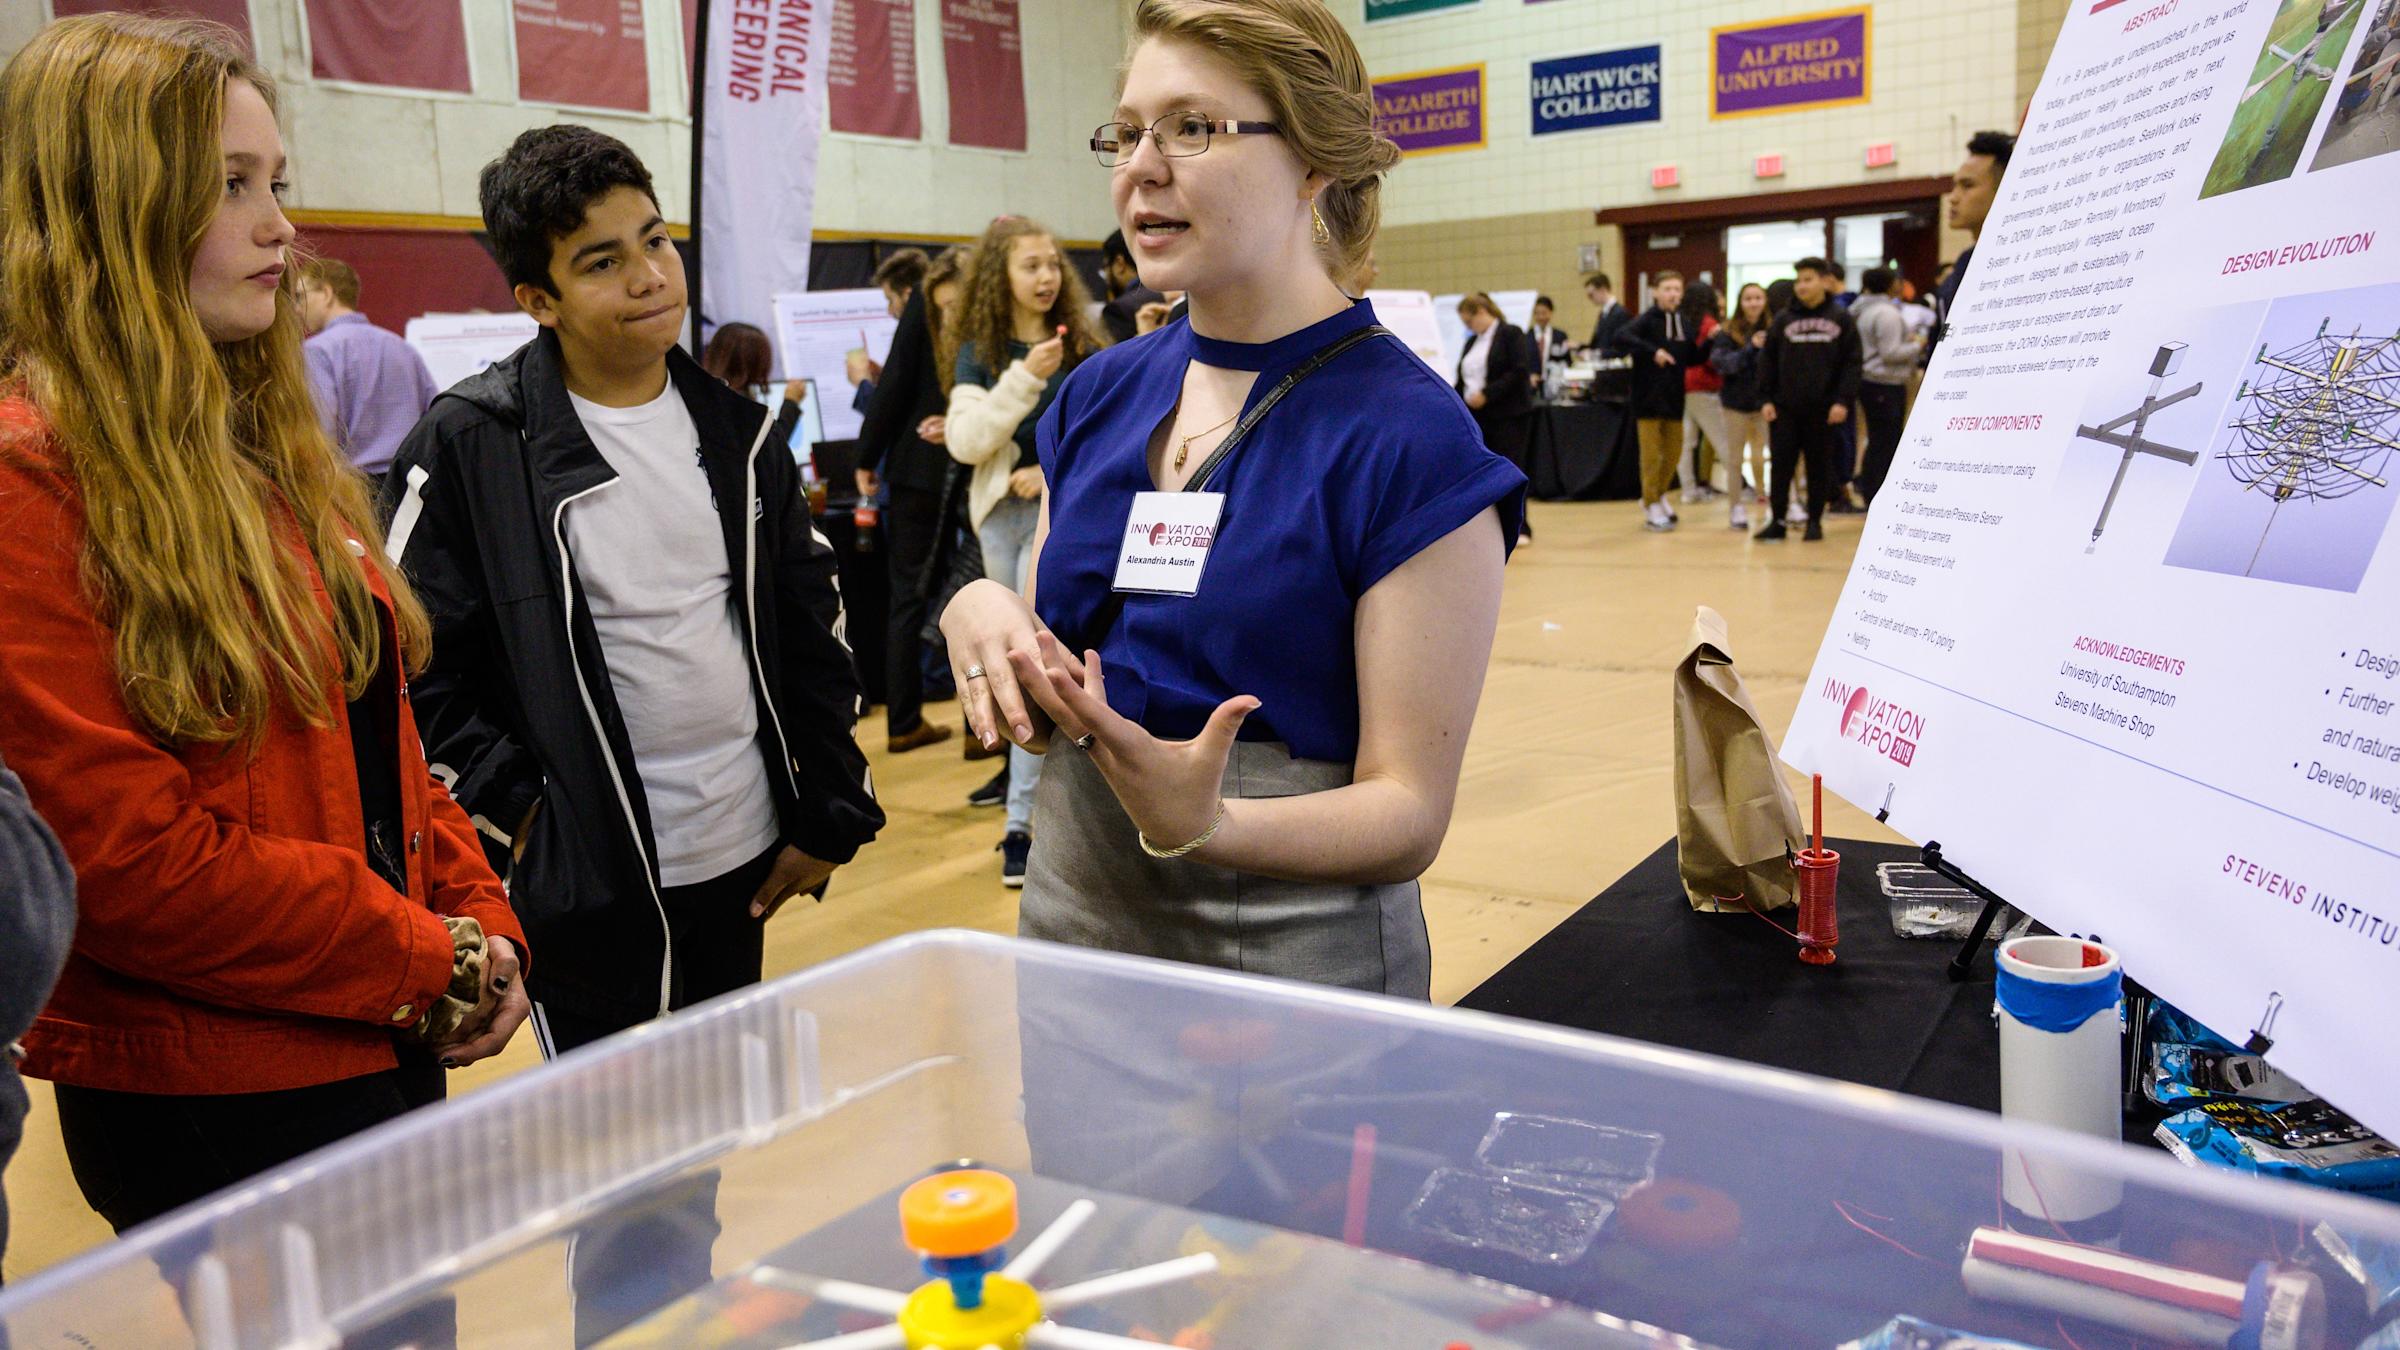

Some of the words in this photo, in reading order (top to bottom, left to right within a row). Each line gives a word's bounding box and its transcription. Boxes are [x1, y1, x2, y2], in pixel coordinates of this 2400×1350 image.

[2122, 0, 2179, 33] ABSTRACT
[1739, 37, 1840, 69] ALFRED
[1532, 62, 1659, 99] HARTWICK
[1718, 56, 1863, 94] UNIVERSITY
[1540, 87, 1651, 120] COLLEGE
[2222, 249, 2278, 275] DESIGN
[2278, 231, 2376, 266] EVOLUTION
[1947, 417, 1982, 430] SYSTEM
[1982, 414, 2042, 430] COMPONENTS
[1920, 436, 1932, 447] Hub
[1919, 458, 1942, 470] Custom
[1942, 460, 1983, 473] manufactured
[1982, 463, 2013, 474] aluminum
[2013, 466, 2035, 479] casing
[1901, 478, 1923, 491] Sensor
[1922, 482, 1937, 493] suite
[1901, 501, 1917, 514] Dual
[1979, 511, 2003, 525] Sensor
[1155, 534, 1191, 547] EXPO
[1908, 528, 1929, 542] rotating
[1928, 532, 1951, 543] camera
[1126, 556, 1166, 565] Alexandria
[1168, 557, 1194, 566] Austin
[1884, 546, 1905, 559] Inertial
[1904, 548, 1942, 566] Measurement
[1941, 556, 1955, 569] Unit
[1868, 564, 1892, 580] Physical
[1891, 570, 1916, 586] Structure
[1867, 589, 1888, 603] Anchor
[1860, 610, 1880, 625] Central
[1892, 622, 1904, 633] and
[1922, 628, 1937, 643] PVC
[1935, 635, 1955, 652] piping
[2073, 636, 2186, 676] ACKNOWLEDGEMENTS
[2355, 649, 2400, 679] Desig
[2060, 660, 2102, 688] University
[2102, 674, 2114, 688] of
[2112, 676, 2176, 708] Southampton
[2055, 691, 2089, 714] Stevens
[2089, 702, 2128, 728] Machine
[2128, 715, 2155, 740] Shop
[2339, 686, 2395, 716] Further
[1846, 709, 1892, 754] EXPO
[1891, 739, 1914, 765] 2019
[2322, 728, 2354, 748] and
[2306, 761, 2366, 798] Develop
[2223, 854, 2307, 904] STEVENS
[2311, 892, 2400, 949] INSTITU
